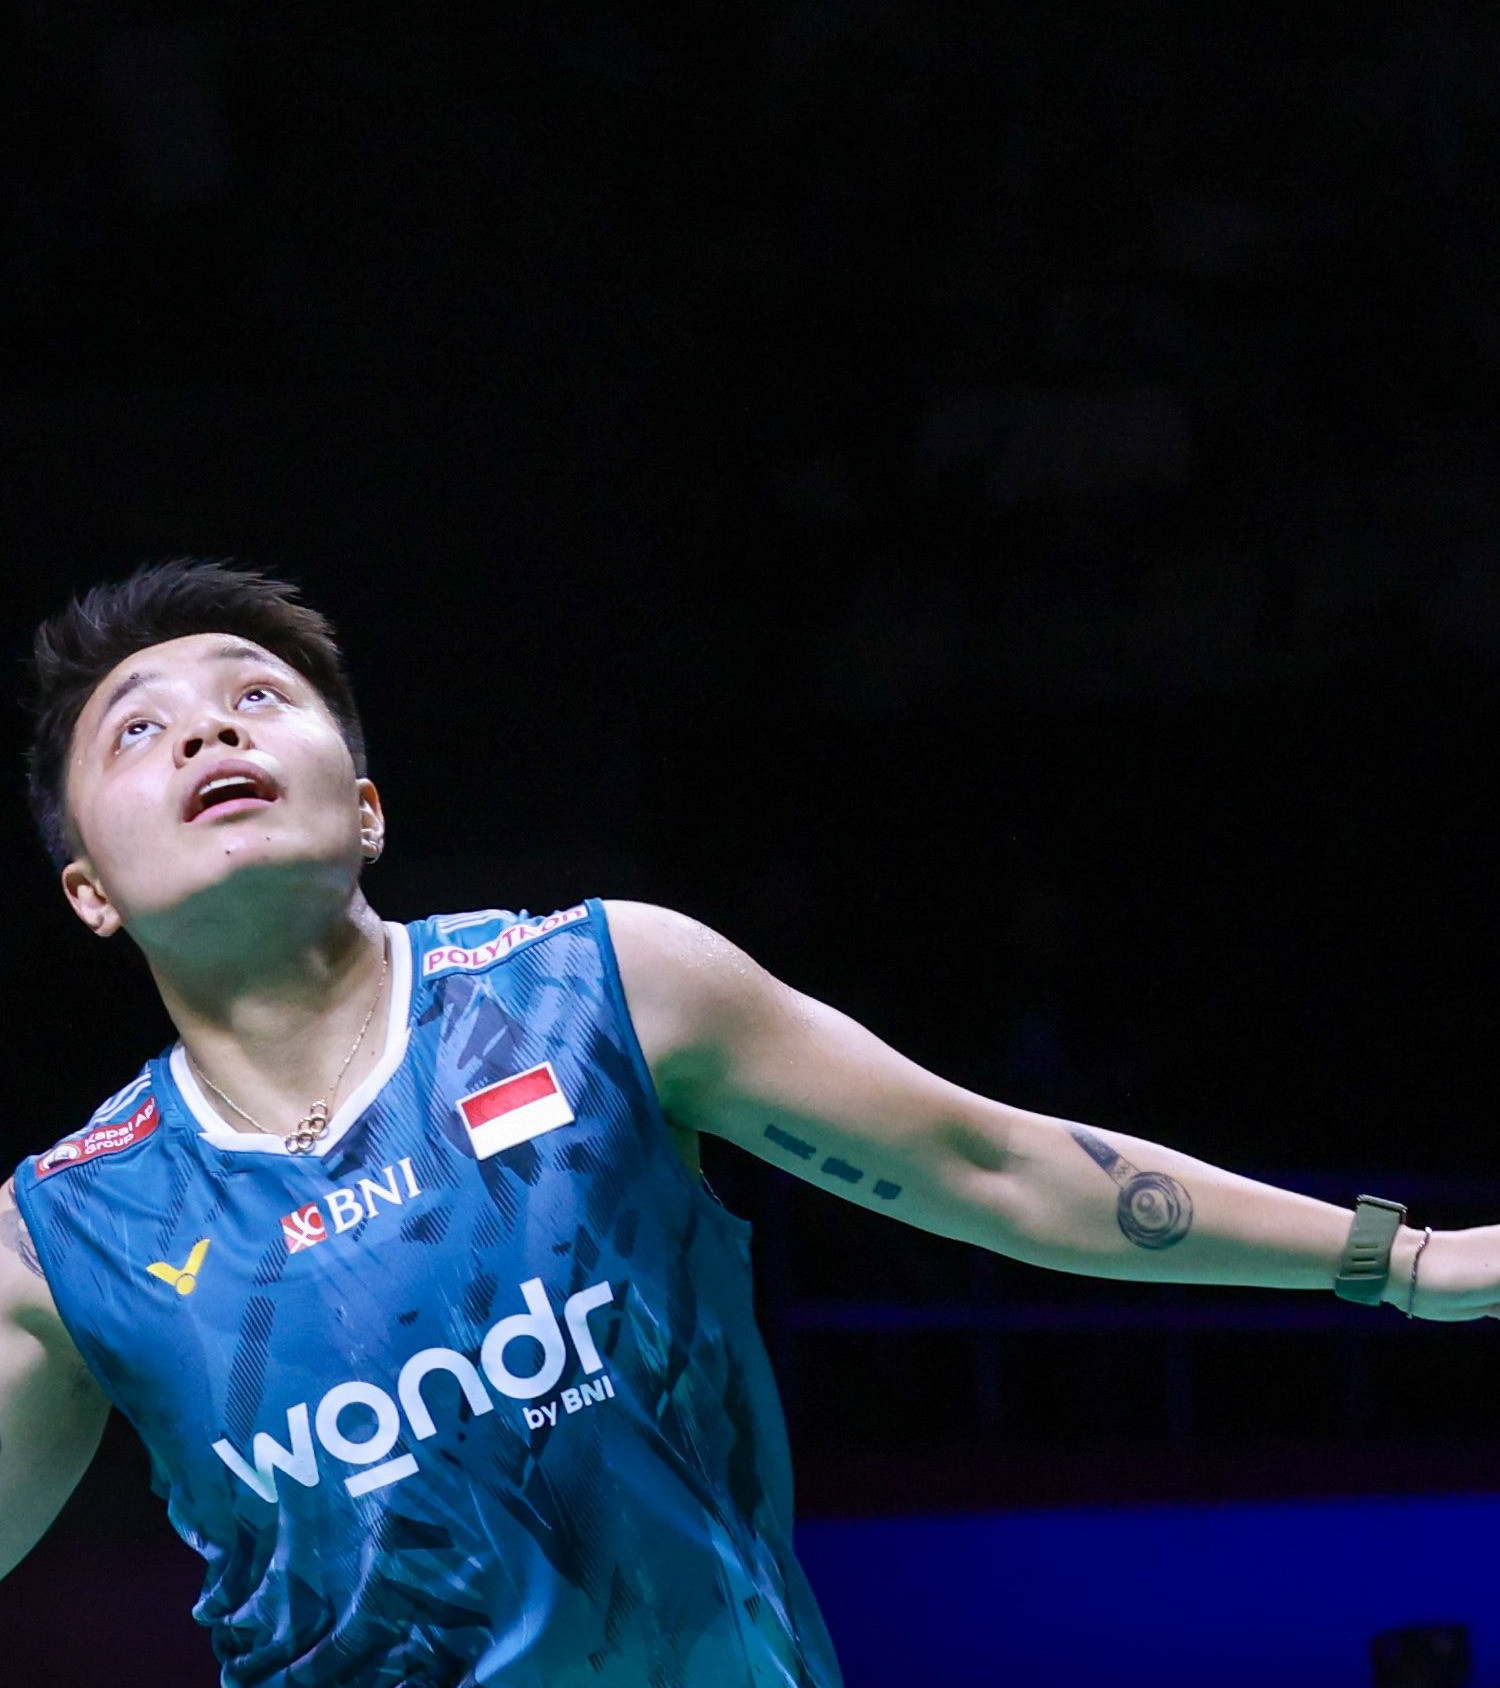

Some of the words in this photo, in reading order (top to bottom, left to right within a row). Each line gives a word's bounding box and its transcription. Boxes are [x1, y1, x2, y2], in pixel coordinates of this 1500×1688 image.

[84, 1121, 133, 1147] Kapal
[84, 1133, 134, 1154] Group
[323, 1156, 421, 1234] BNI
[212, 1277, 614, 1503] wondr
[522, 1401, 556, 1430] by
[561, 1375, 615, 1414] BNI
